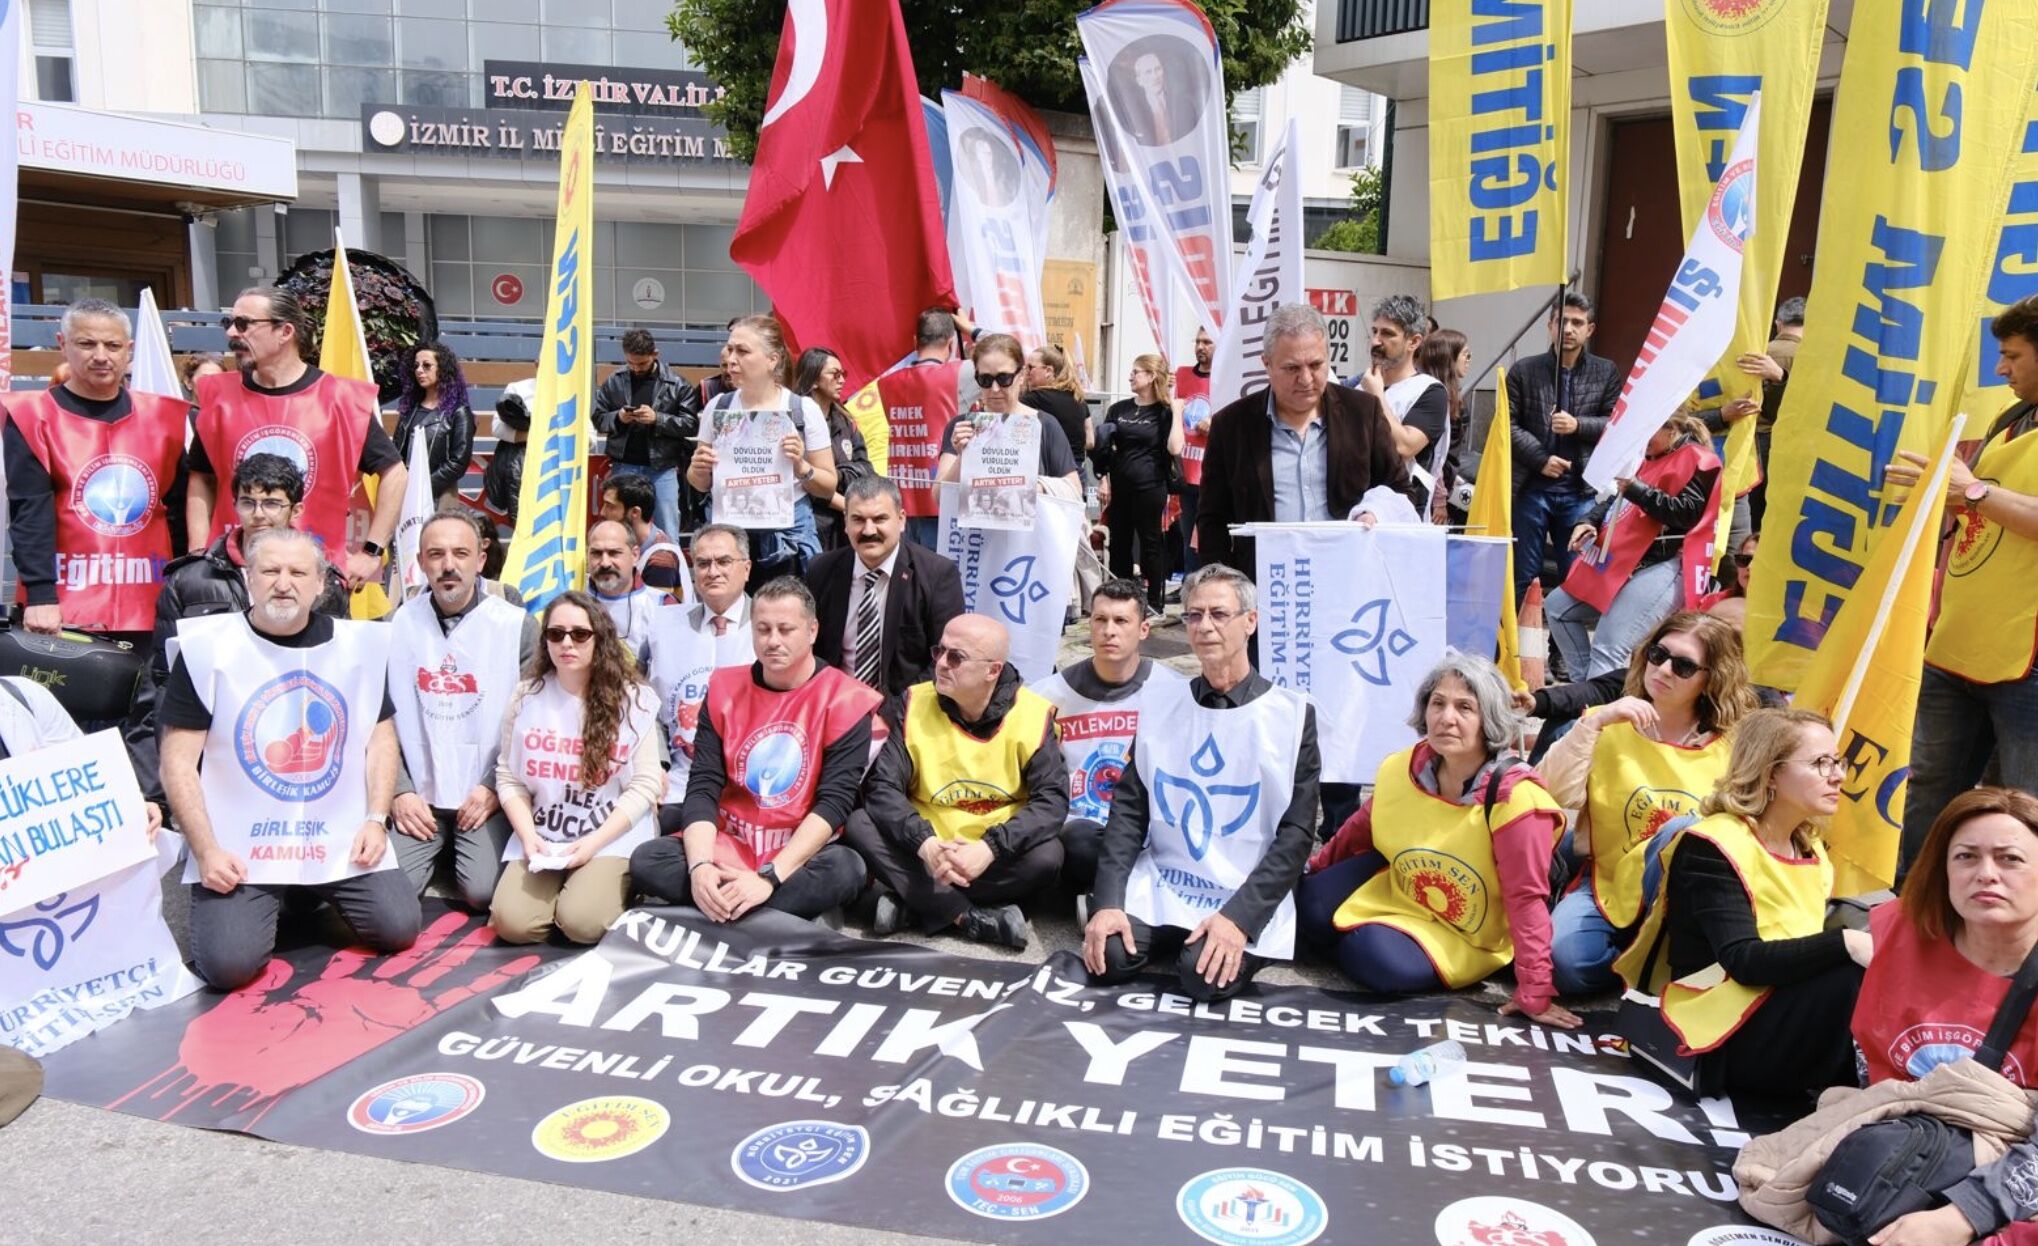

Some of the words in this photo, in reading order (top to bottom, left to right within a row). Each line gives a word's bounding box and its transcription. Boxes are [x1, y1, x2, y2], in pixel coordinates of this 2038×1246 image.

[490, 75, 539, 99] T.C.
[631, 80, 727, 108] VALİLİ
[409, 115, 491, 148] İZMİR
[498, 119, 524, 150] İL
[611, 126, 705, 160] EĞİTİM
[43, 139, 115, 166] EĞİTİM
[120, 149, 247, 182] MÜDÜRLÜĞÜ
[890, 406, 923, 420] EMEK
[888, 442, 938, 459] İRENİŞ
[1295, 557, 1314, 693] HÜRRİYE
[565, 783, 595, 810] İLE
[26, 799, 124, 858] BULAŞTI
[250, 817, 329, 841] BİRLEŞİK
[1398, 857, 1442, 874] ĞİTİM
[608, 909, 808, 982] KULLAR
[1117, 993, 1388, 1037] GELECEK
[0, 957, 160, 1033] ÜRRİYETÇİ
[491, 950, 1015, 1072] ARTIK
[1062, 1021, 1752, 1148] YETER!
[437, 1030, 675, 1081] GÜVENLİ
[678, 1064, 843, 1109] OKUL,
[864, 1077, 1138, 1137] SAĞLIKLI
[1157, 1112, 1385, 1163] EĞİTİM
[763, 1175, 799, 1186] 2021
